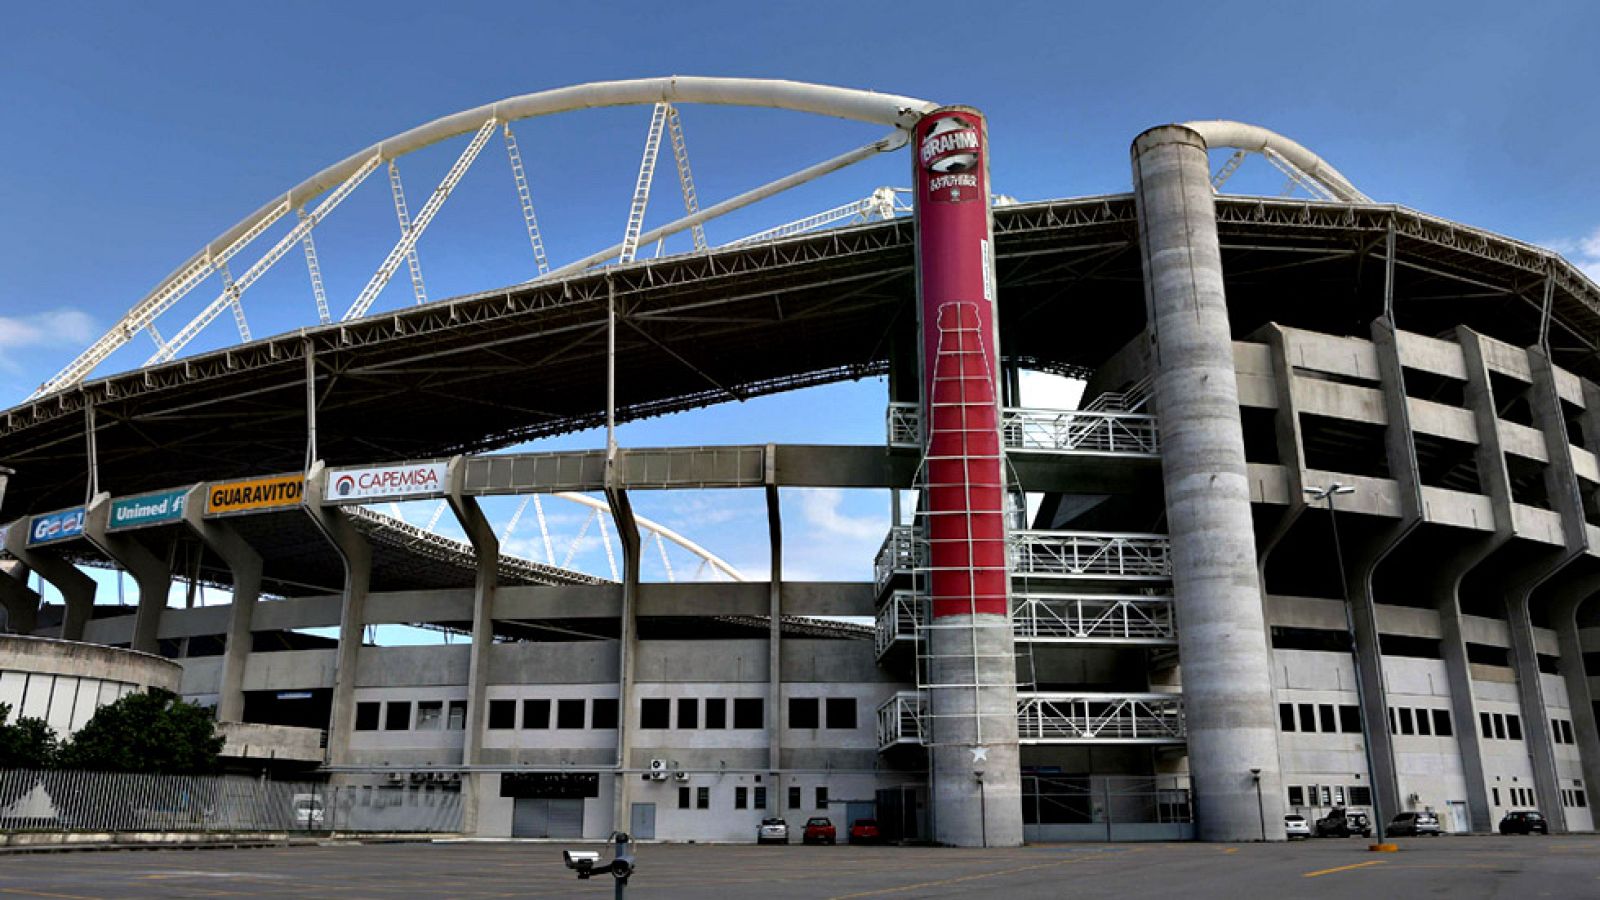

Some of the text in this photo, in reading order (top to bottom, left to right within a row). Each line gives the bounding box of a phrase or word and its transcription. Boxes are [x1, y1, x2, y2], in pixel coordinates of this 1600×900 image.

[922, 132, 979, 161] BRAHMA
[358, 468, 438, 489] CAPEMISA
[116, 499, 168, 521] Unimed
